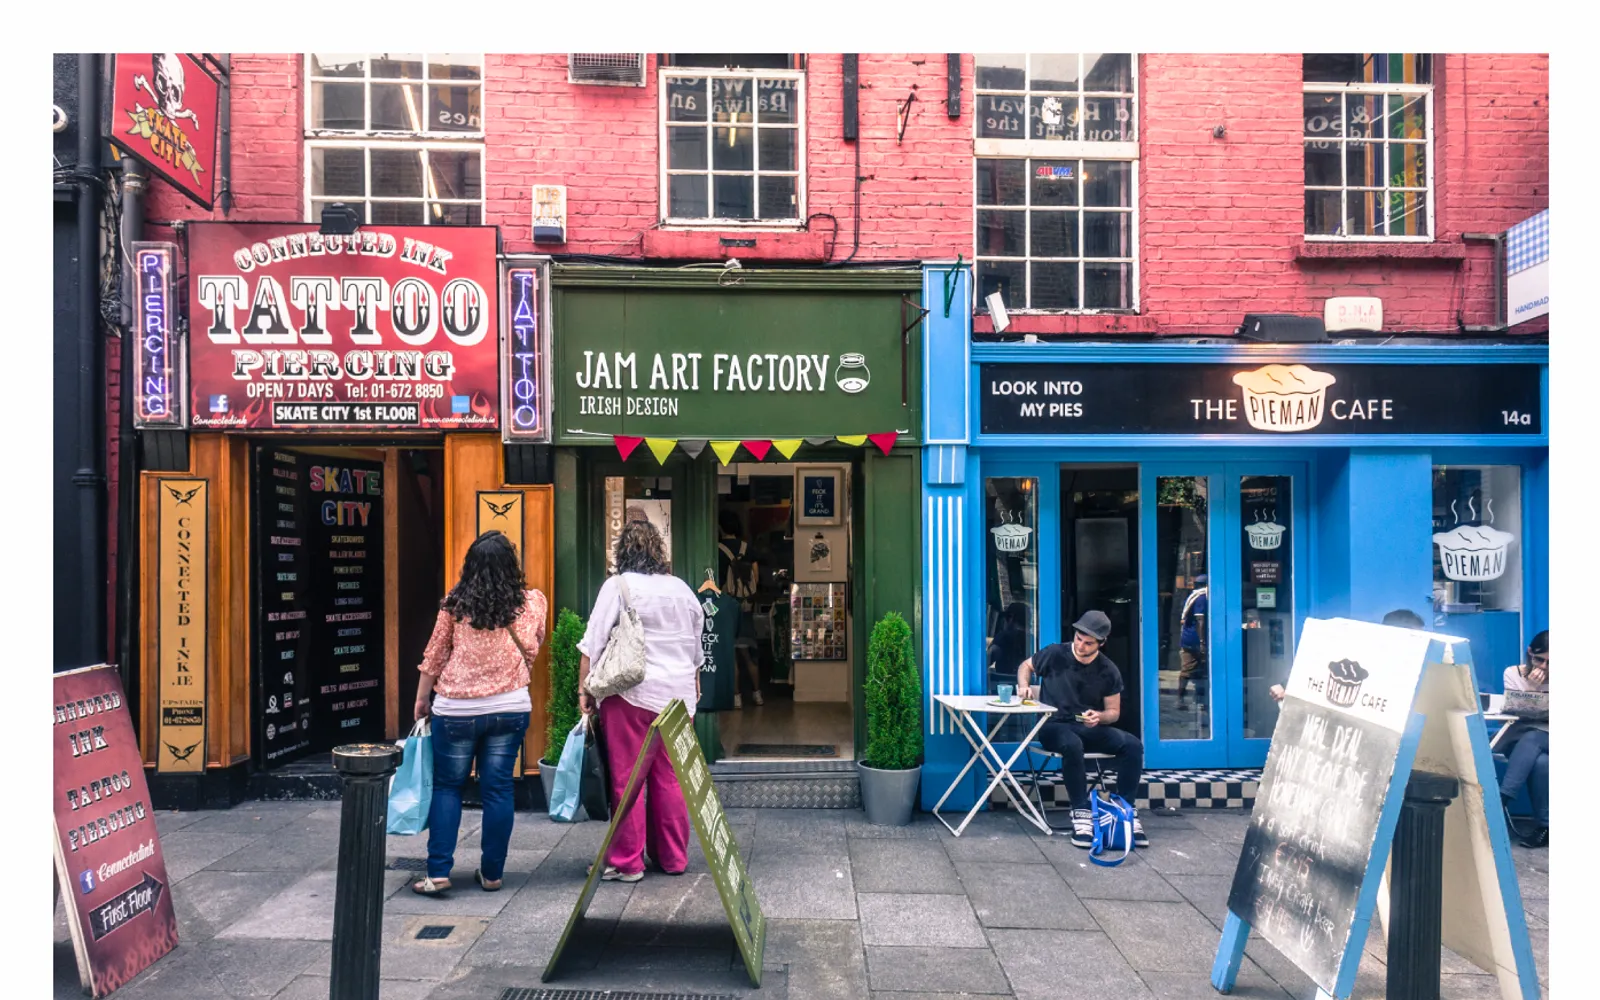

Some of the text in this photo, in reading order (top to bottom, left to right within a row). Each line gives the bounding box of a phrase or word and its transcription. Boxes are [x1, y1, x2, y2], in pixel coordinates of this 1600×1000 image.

[148, 107, 188, 150] SKATE
[151, 133, 182, 168] CITY
[233, 231, 453, 275] CONNECTED INK
[198, 275, 489, 346] TATTOO
[143, 254, 164, 414] PIERCING
[514, 273, 536, 427] TATTOO
[231, 349, 456, 381] PIERCING
[575, 350, 830, 392] JAM ART FACTORY
[247, 382, 444, 398] OPEN 7 DAYS Tel: 01-672 8850
[992, 381, 1083, 395] LOOK INTO
[192, 414, 247, 425] Connectedink
[276, 406, 417, 420] SKATE CITY 1st FLOOR
[580, 396, 678, 417] IRISH DESIGN
[1020, 403, 1083, 417] MY PIES
[1191, 394, 1393, 426] THE PIEMAN CAFE
[1502, 410, 1532, 425] 14a
[310, 465, 381, 495] SKATE
[321, 500, 371, 526] CITY
[997, 536, 1027, 550] PIEMAN
[1250, 534, 1280, 548] PIEMAN
[177, 517, 190, 626] CONNECTED
[1445, 551, 1503, 577] PIEMAN
[702, 633, 719, 643] ECK
[177, 637, 190, 672] INK
[171, 675, 193, 687] .IE
[1308, 676, 1388, 713] THE PIEMAN CAFE
[69, 725, 109, 757] INK
[67, 770, 132, 811] TATTOO
[68, 801, 146, 852] PIERCING
[101, 887, 152, 931] First Floor
